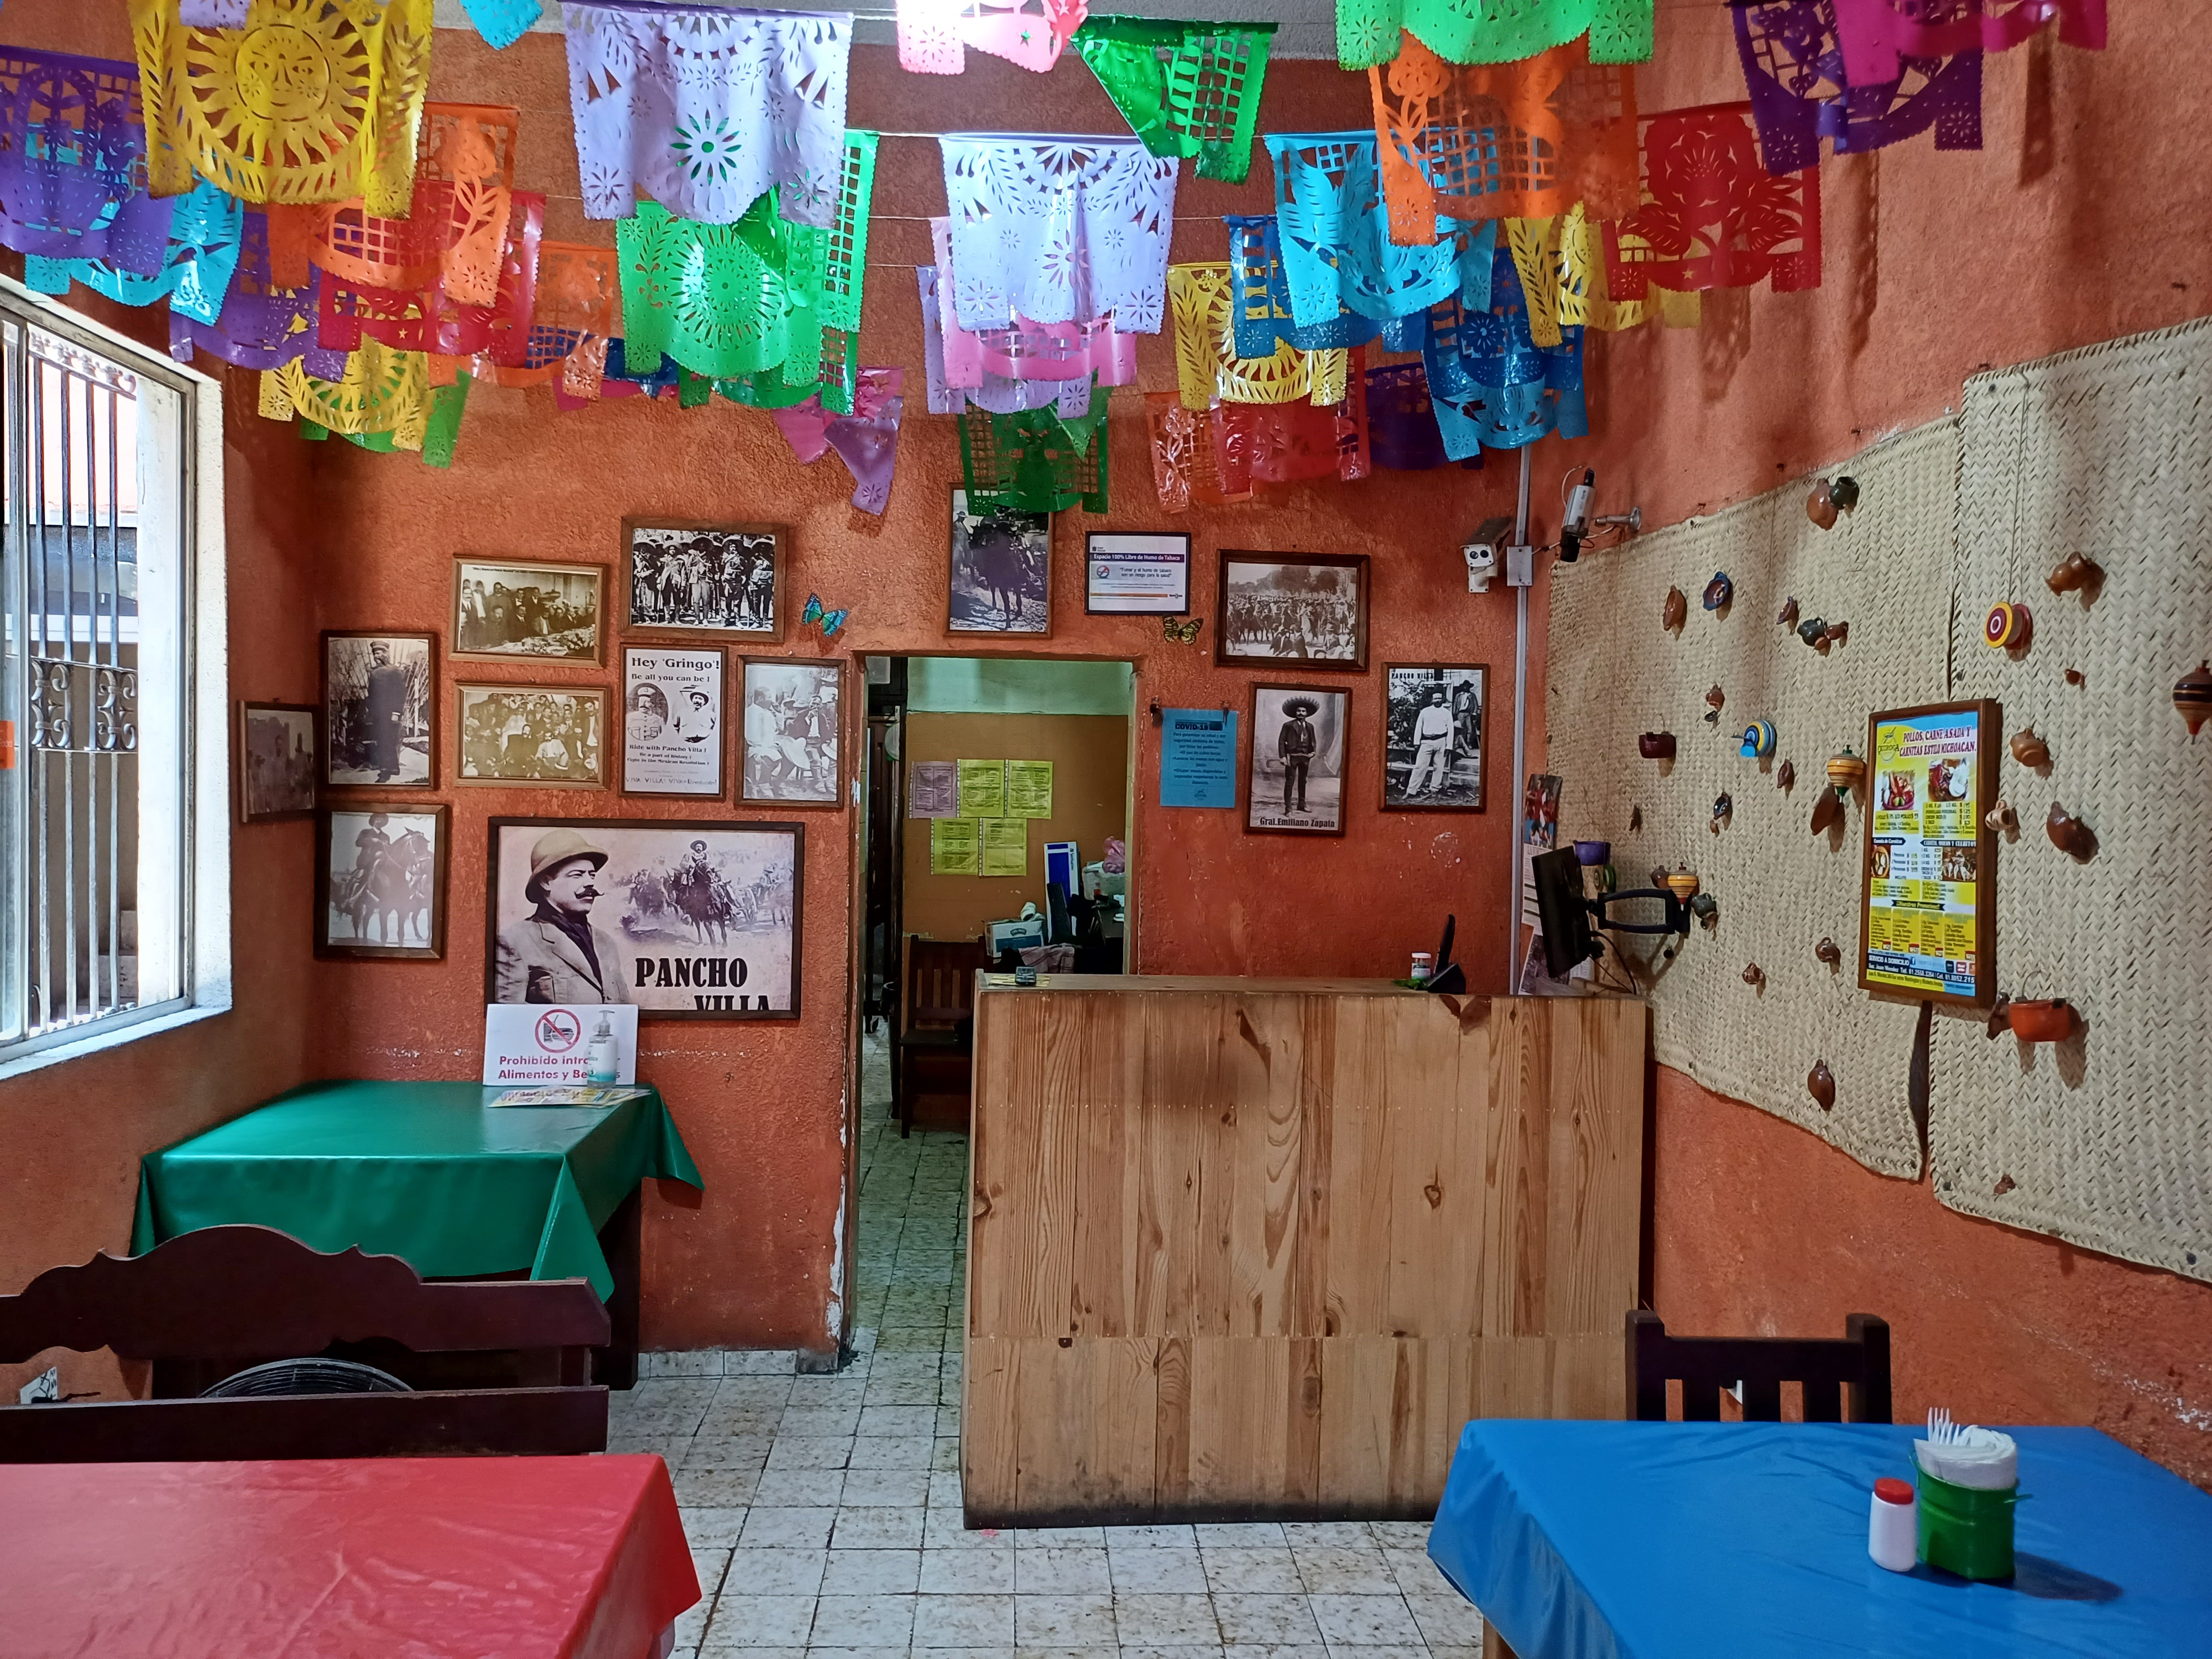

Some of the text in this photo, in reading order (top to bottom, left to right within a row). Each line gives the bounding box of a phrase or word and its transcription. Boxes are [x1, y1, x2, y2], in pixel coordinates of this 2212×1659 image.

[632, 658, 658, 669] Hey
[1903, 726, 1971, 743] POLLOS, CARNE ASADA Y
[1900, 745, 1923, 757] CARNITAS
[1924, 744, 1940, 754] ESTILO
[1311, 819, 1335, 828] Zapata
[635, 957, 748, 988] PANCHO
[499, 1055, 558, 1065] Prohibido
[498, 1070, 559, 1079] Alimentos
[562, 1071, 569, 1081] y
